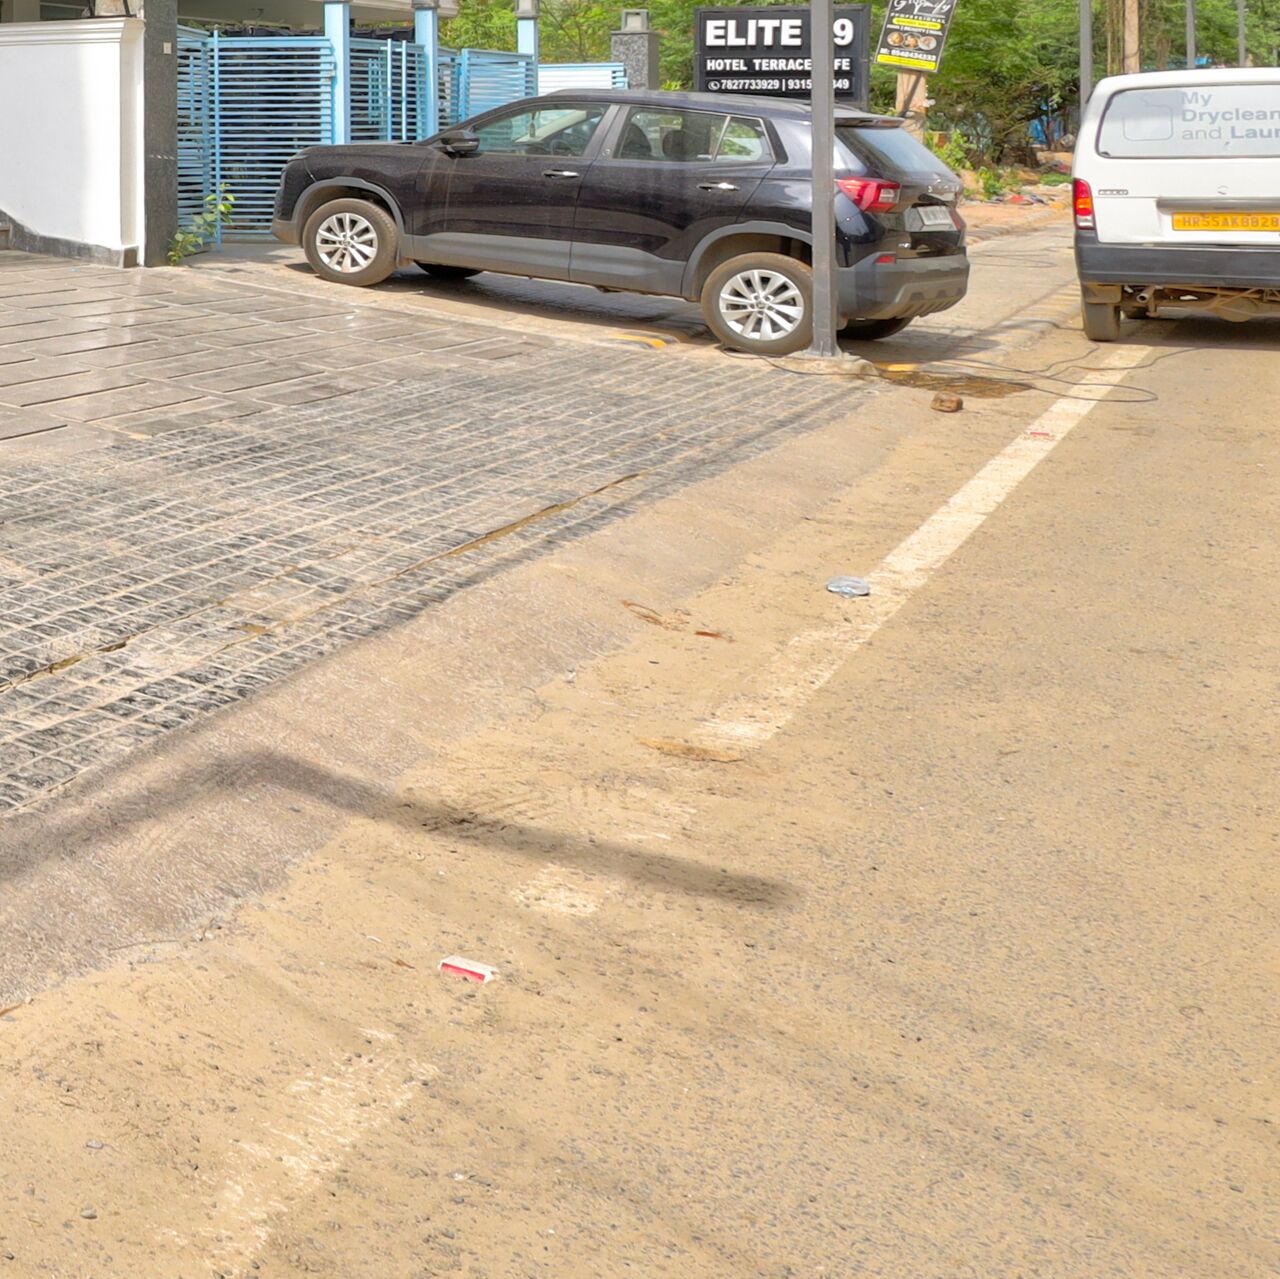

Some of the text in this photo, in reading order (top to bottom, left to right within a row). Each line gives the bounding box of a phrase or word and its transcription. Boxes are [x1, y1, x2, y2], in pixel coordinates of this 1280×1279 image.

[705, 19, 802, 46] ELITE
[706, 58, 748, 71] HOTEL
[753, 58, 812, 71] TERRACE
[721, 79, 779, 90] 7827733929
[1182, 91, 1213, 108] My
[1182, 126, 1222, 140] and
